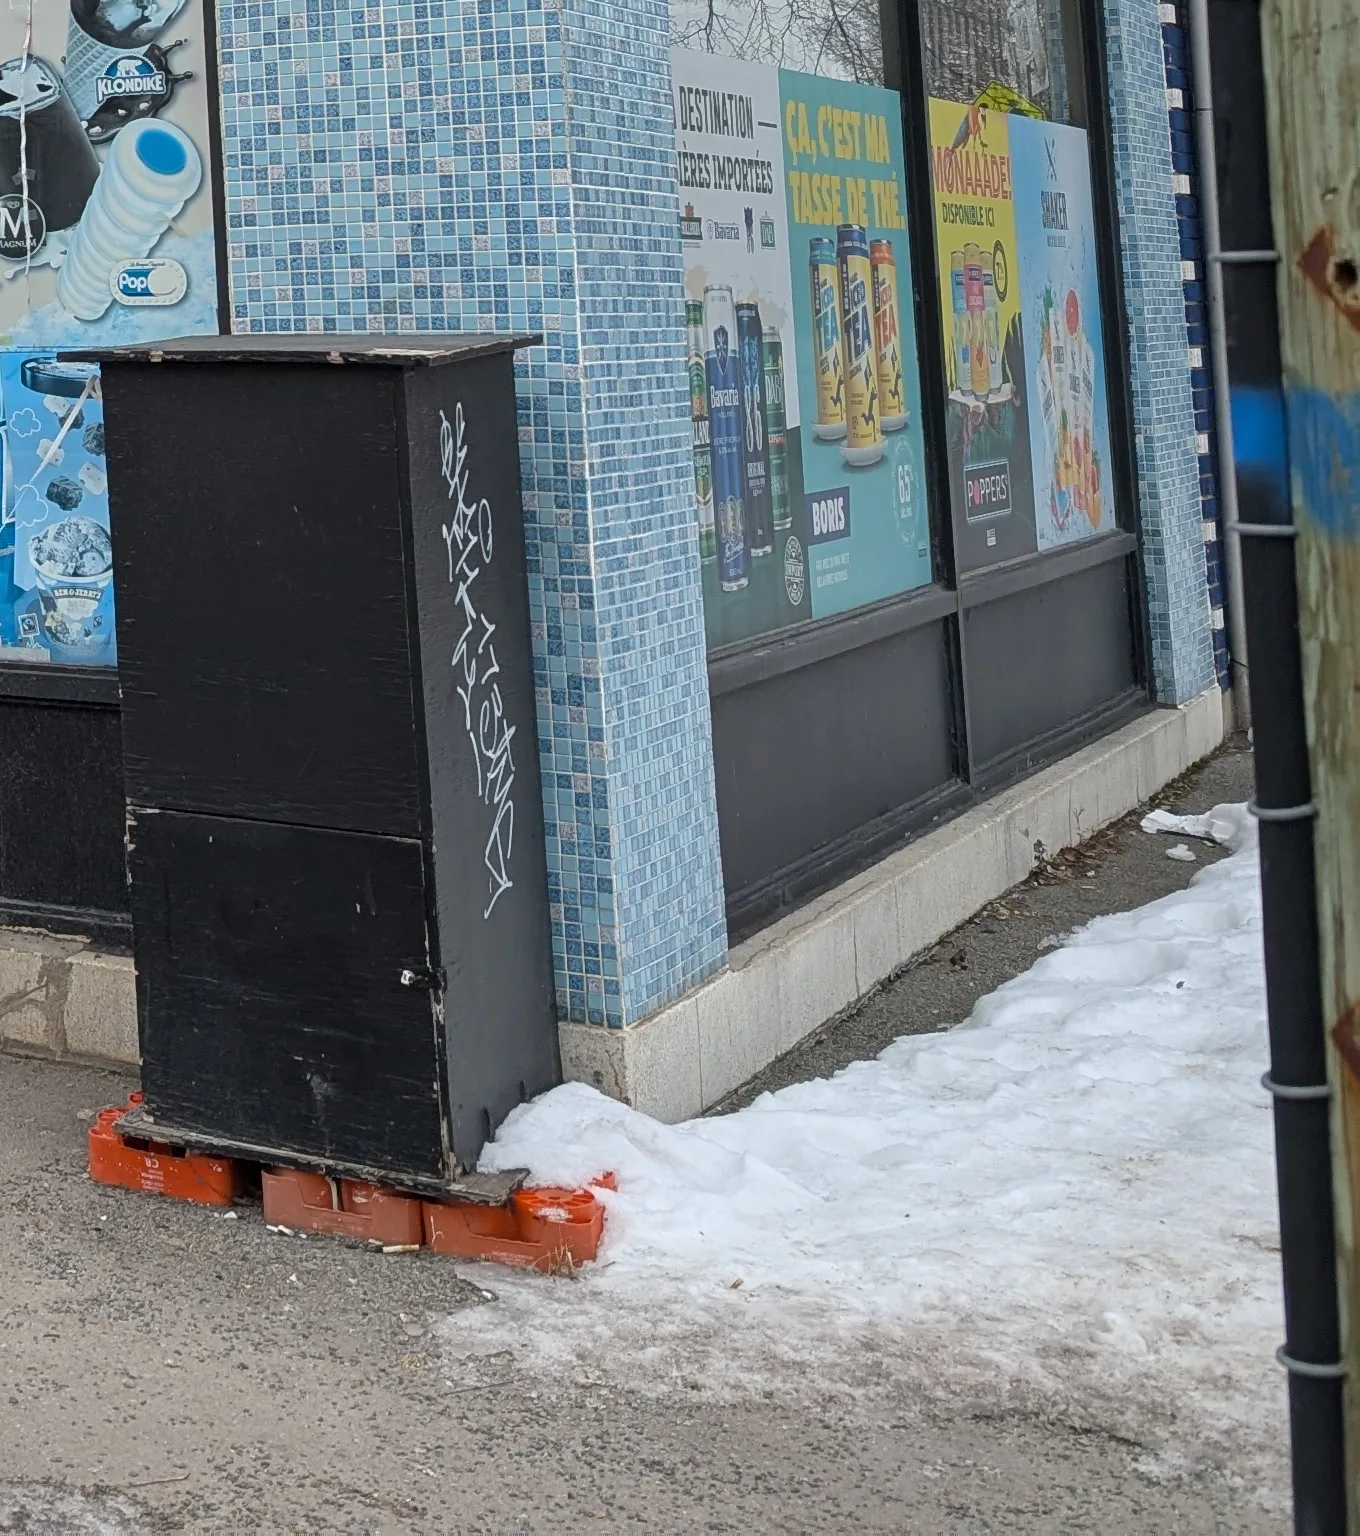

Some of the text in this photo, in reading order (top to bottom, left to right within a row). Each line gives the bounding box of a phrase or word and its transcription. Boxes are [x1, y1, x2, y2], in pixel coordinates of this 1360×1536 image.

[96, 76, 165, 104] KLONDIKE
[679, 85, 754, 140] DESTINATION
[785, 98, 891, 166] ÇA, C'EST MA
[712, 149, 773, 195] IMPORTÉES
[788, 170, 843, 227] TASSE
[846, 176, 869, 228] DE
[942, 201, 995, 228] DISPONIBLE ICI
[1040, 190, 1069, 231] SHAKER
[843, 304, 873, 366] TEA
[709, 382, 740, 408] Bavaria
[967, 473, 1008, 508] POPPERS
[812, 496, 845, 536] BORIS
